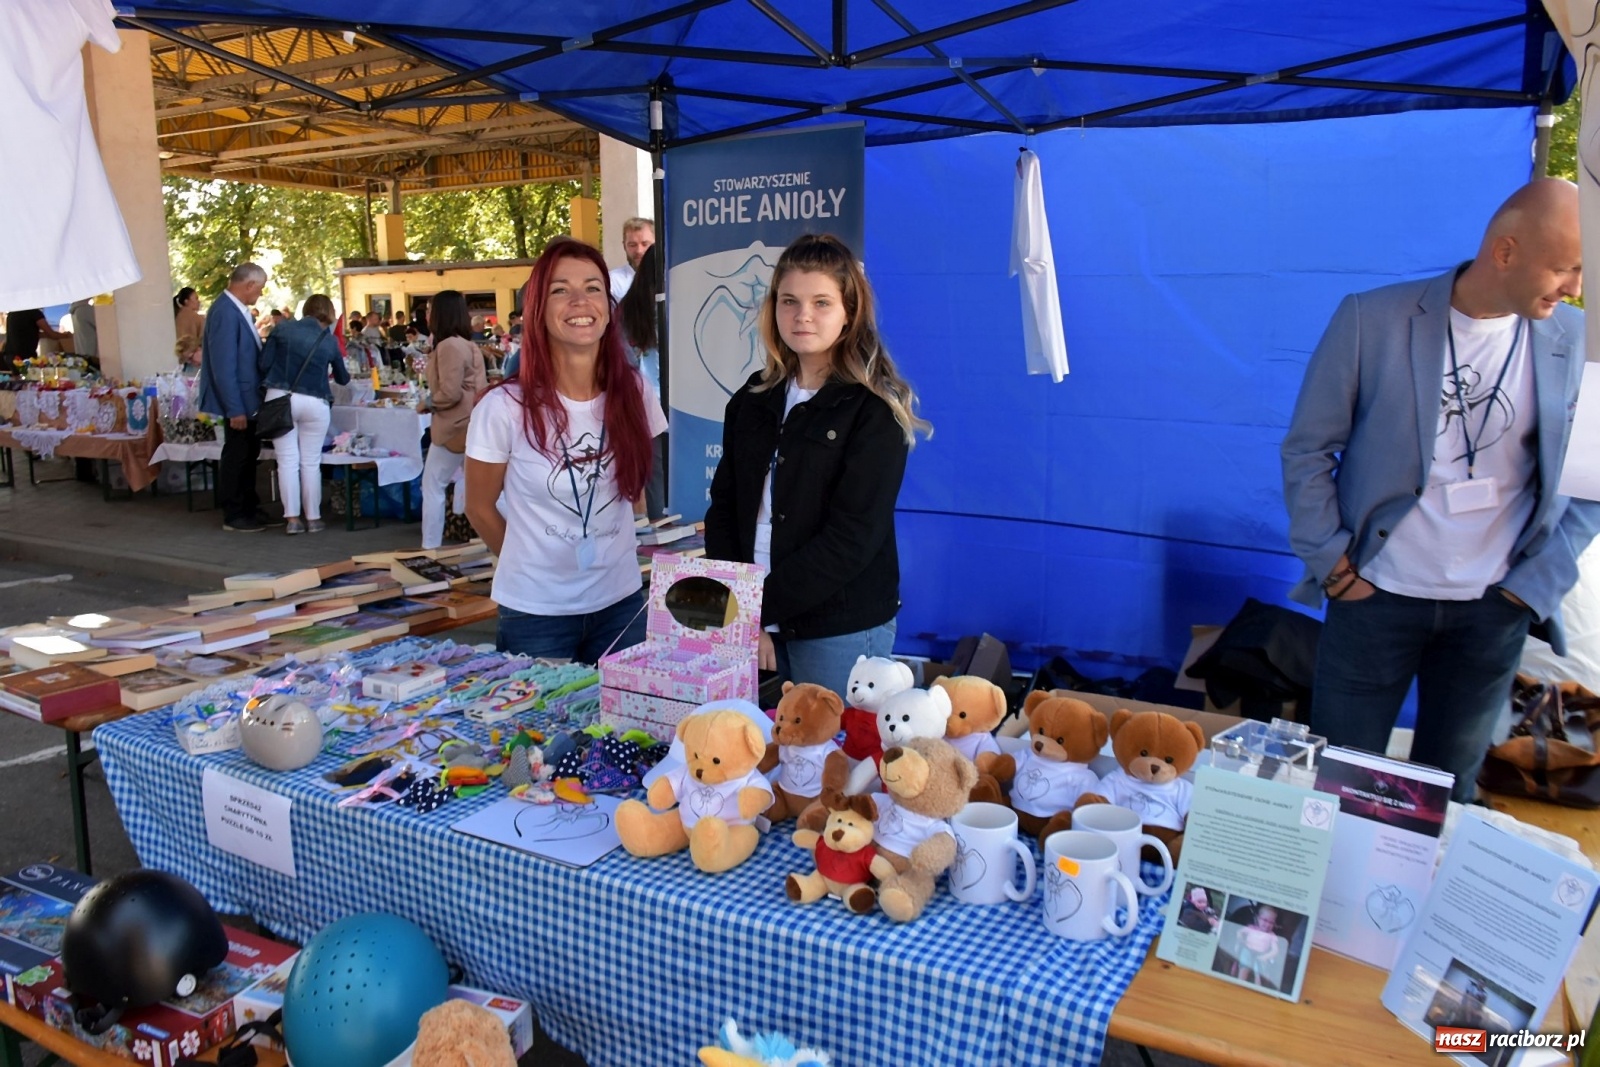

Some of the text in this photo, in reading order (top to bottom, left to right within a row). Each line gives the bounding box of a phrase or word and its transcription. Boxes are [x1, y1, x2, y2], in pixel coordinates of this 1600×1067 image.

[713, 171, 811, 193] STOWARZYSZENIE
[682, 187, 847, 227] CICHE ANIOŁY
[705, 444, 723, 458] KR
[705, 466, 718, 479] N
